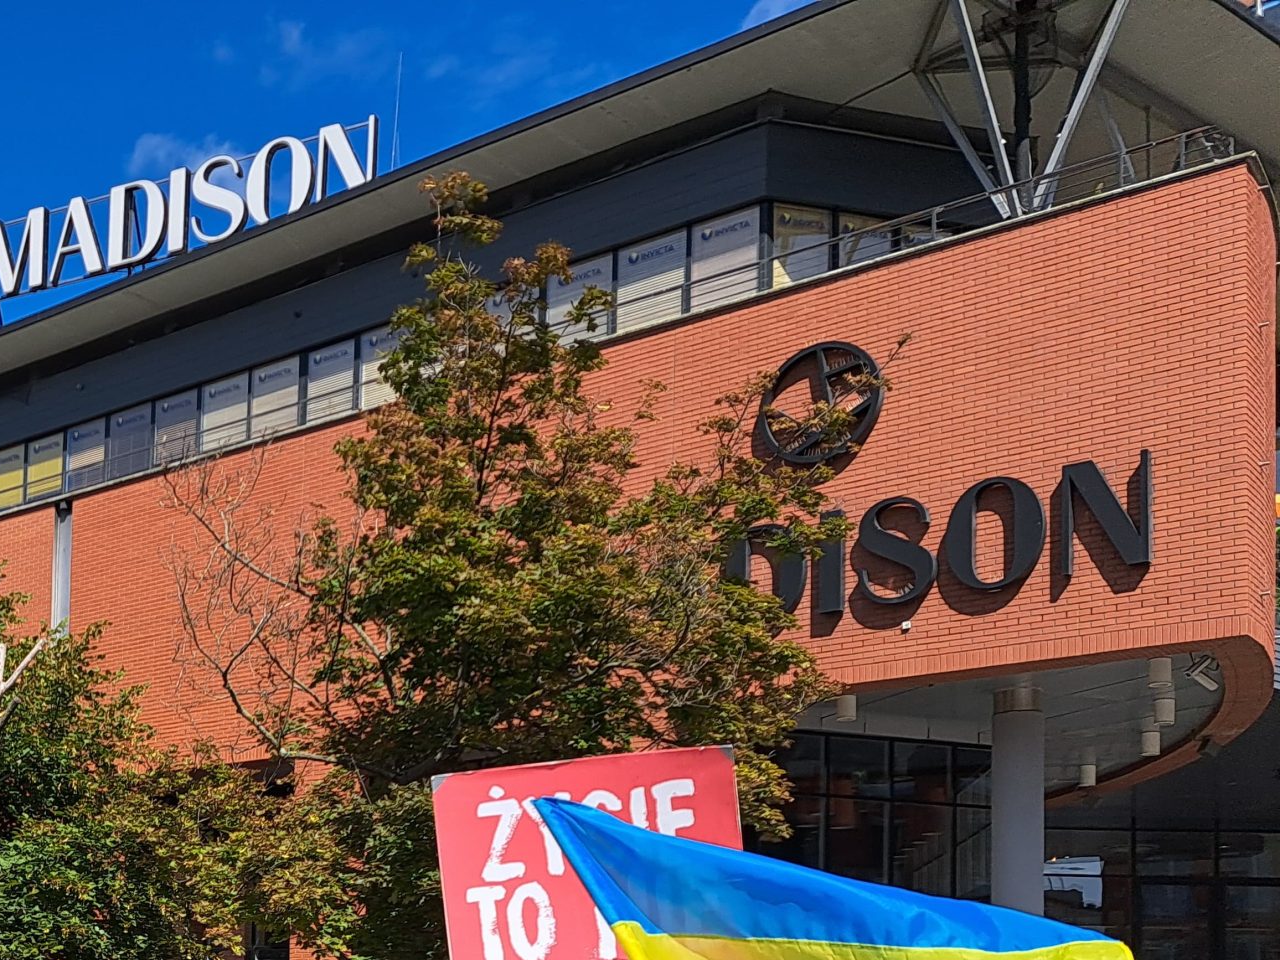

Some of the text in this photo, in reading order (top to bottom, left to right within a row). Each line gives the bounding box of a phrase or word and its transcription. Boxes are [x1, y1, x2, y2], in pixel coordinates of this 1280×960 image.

[641, 244, 675, 261] INVICTA
[715, 220, 751, 237] INVICTA
[726, 449, 1152, 617] DISON
[477, 779, 696, 883] ŻYIE
